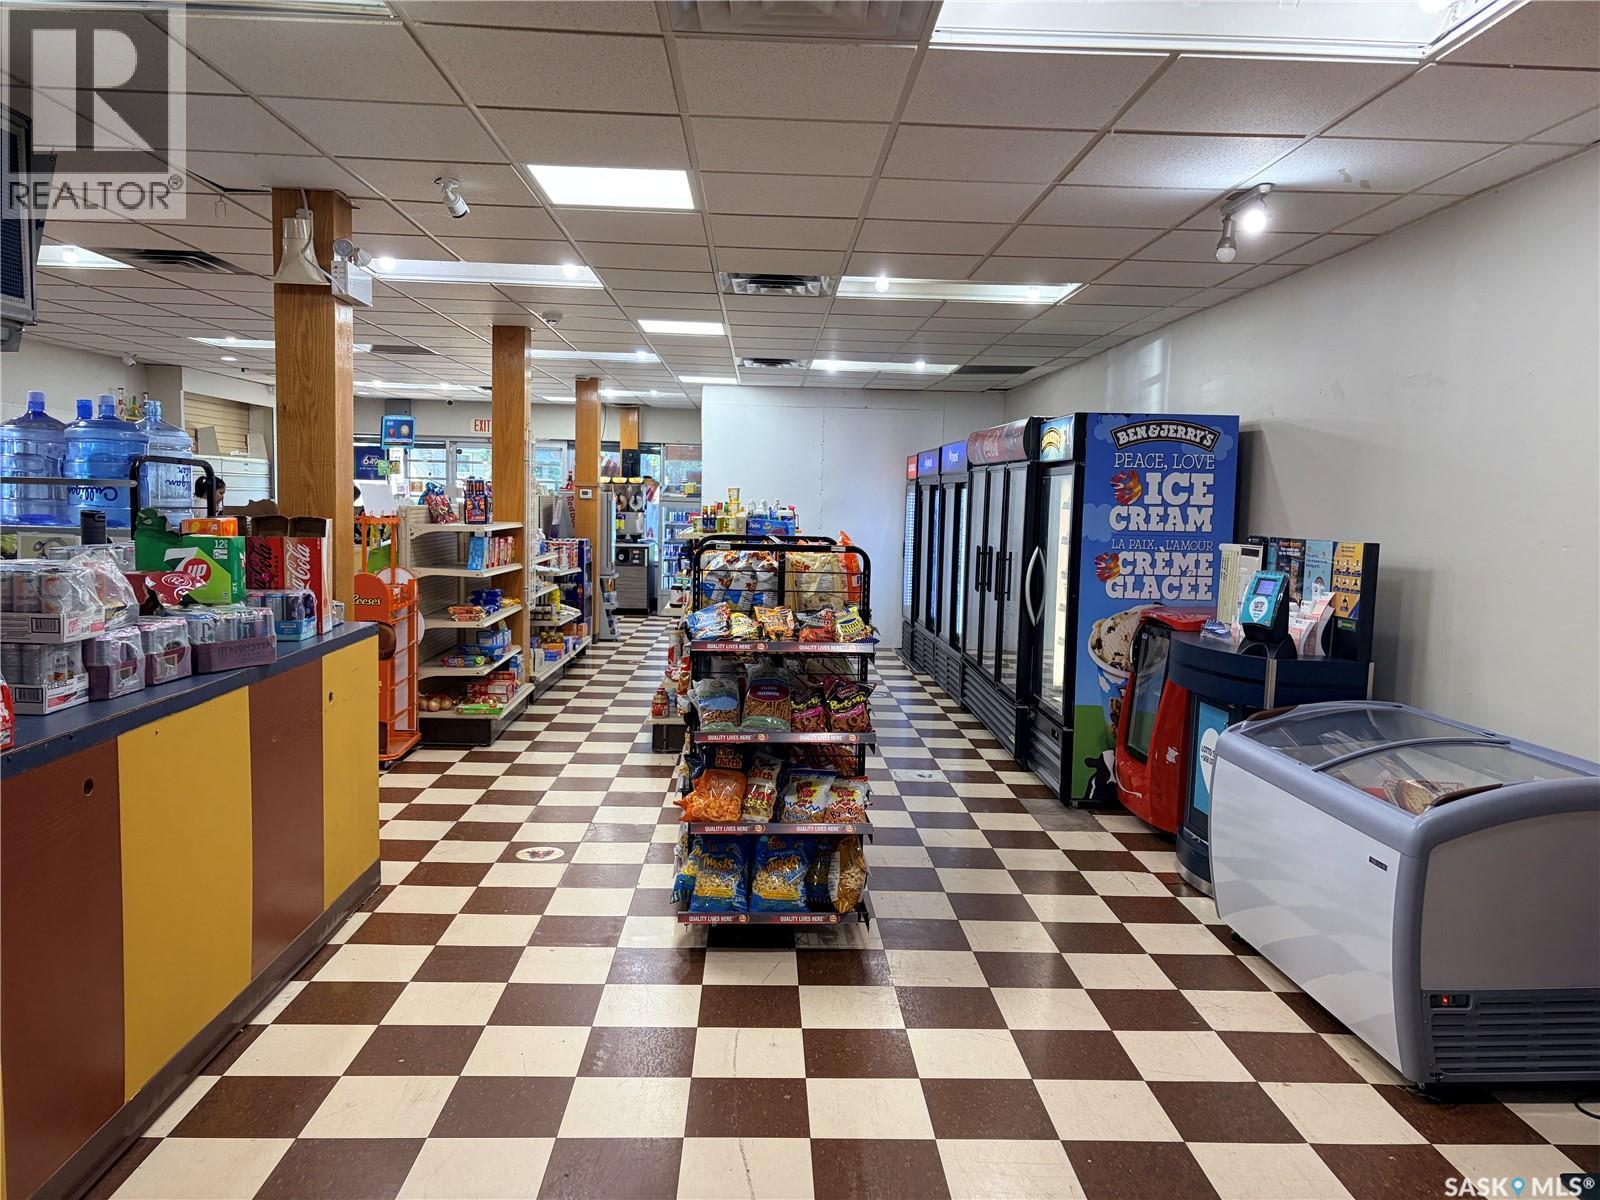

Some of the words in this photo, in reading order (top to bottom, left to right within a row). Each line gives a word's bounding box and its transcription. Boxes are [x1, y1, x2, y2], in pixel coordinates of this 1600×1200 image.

[473, 418, 491, 433] EXIT
[1114, 453, 1168, 471] PEACE,
[1172, 453, 1215, 470] LOVE
[1143, 472, 1214, 506] ICE
[1109, 505, 1213, 532] CREAM
[1111, 539, 1125, 549] LA
[1129, 540, 1158, 551] PAIX,
[1165, 540, 1214, 551] L'AMOUR
[1118, 546, 1214, 577] CRÈME
